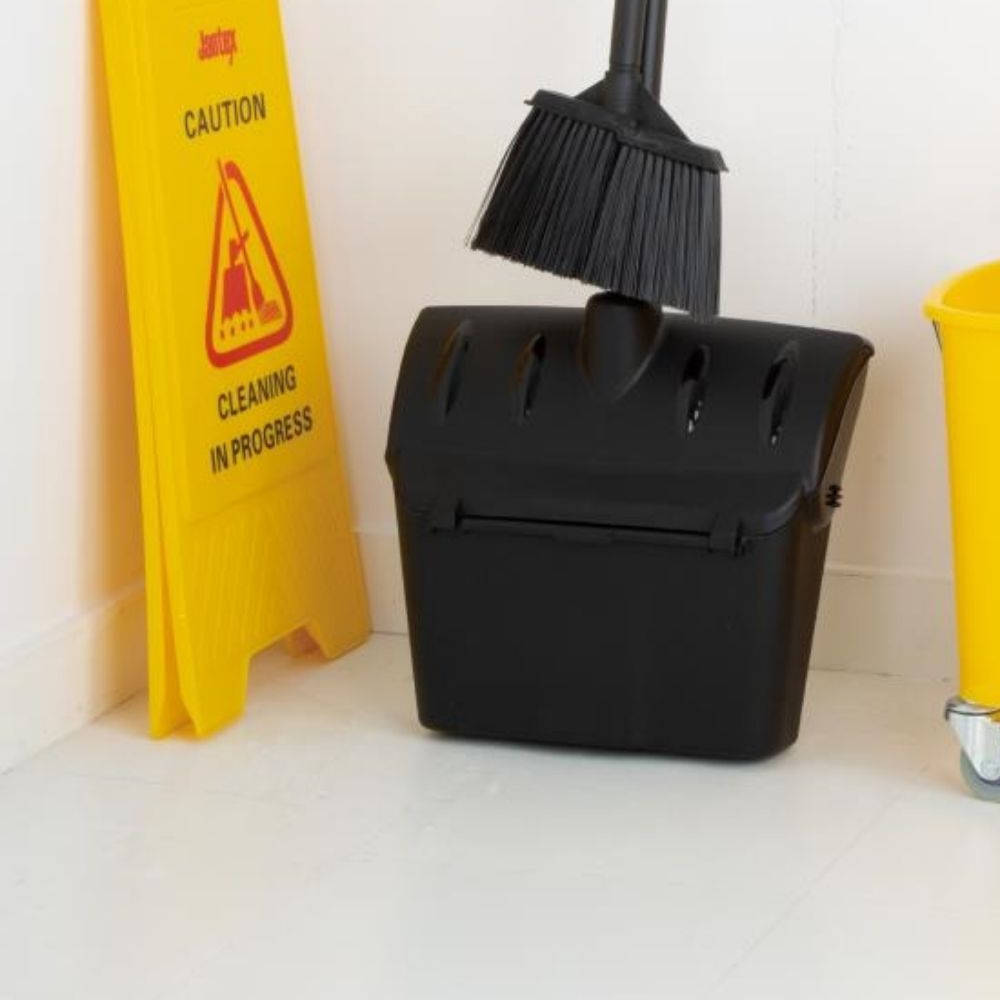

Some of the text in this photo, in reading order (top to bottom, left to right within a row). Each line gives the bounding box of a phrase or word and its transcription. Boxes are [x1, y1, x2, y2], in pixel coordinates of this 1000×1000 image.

[198, 26, 238, 67] Jantex
[184, 92, 267, 139] CAUTION
[217, 364, 297, 420] CLEANING
[210, 405, 314, 475] IN PROGRESS
